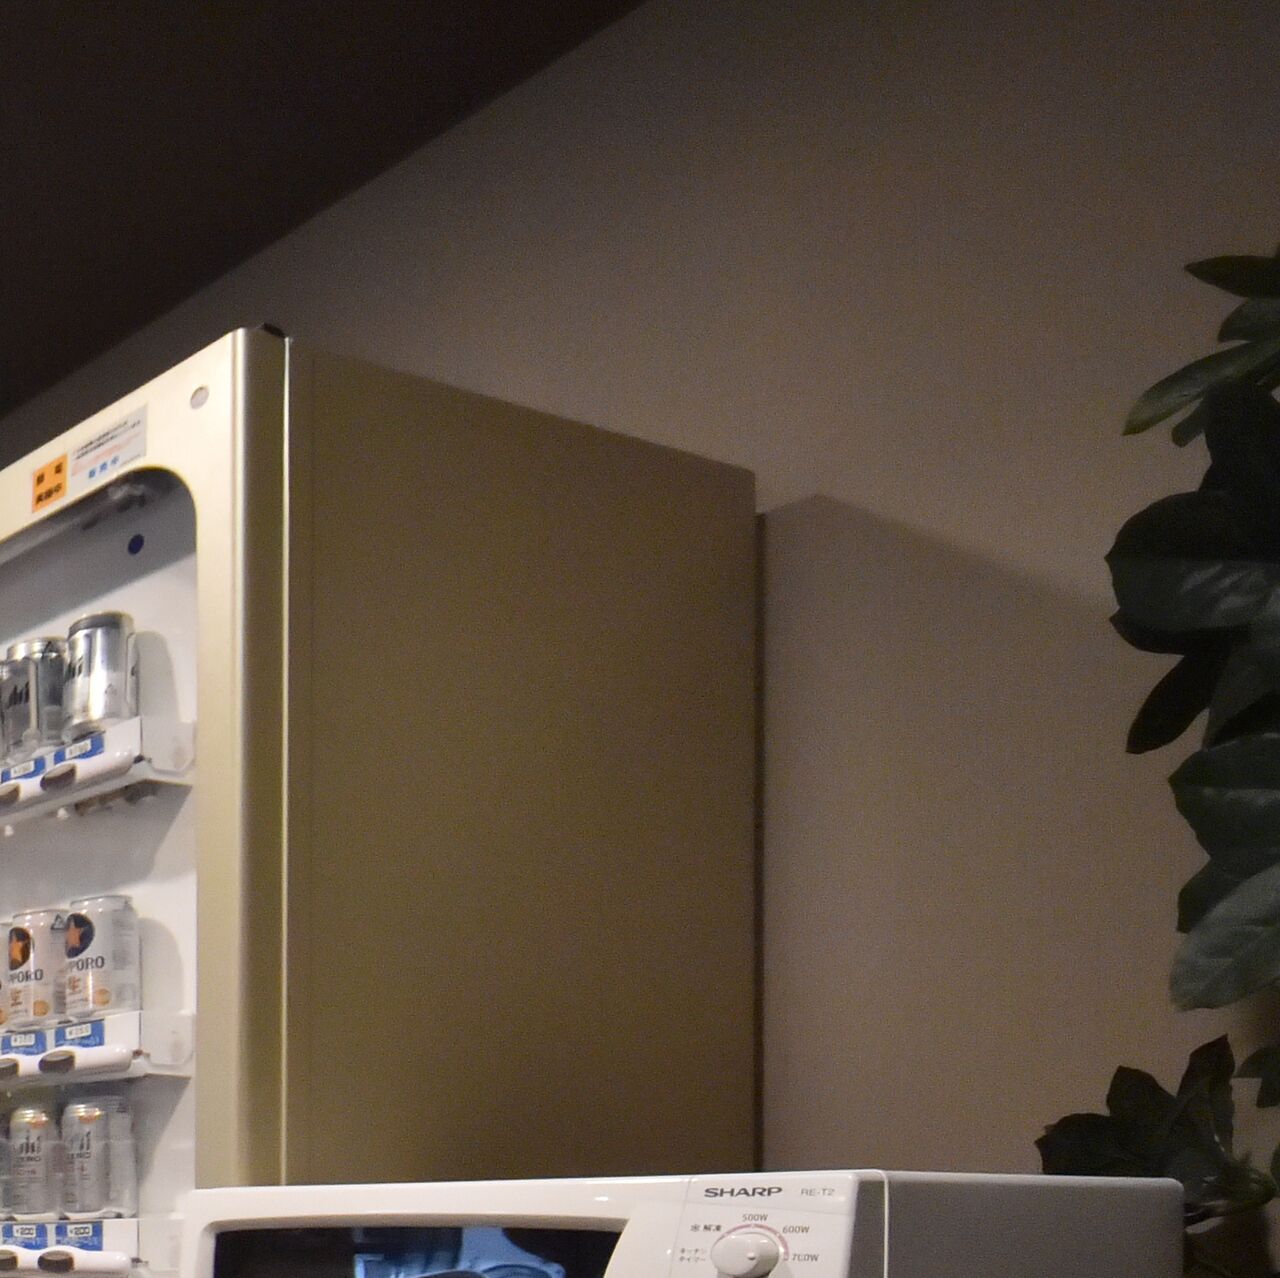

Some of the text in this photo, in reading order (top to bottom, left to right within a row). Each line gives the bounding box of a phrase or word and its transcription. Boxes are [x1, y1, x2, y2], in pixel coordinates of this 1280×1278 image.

[703, 1186, 783, 1198] SHARP
[742, 1213, 769, 1222] 500W
[782, 1225, 810, 1234] 600W
[792, 1252, 820, 1262] 700W
